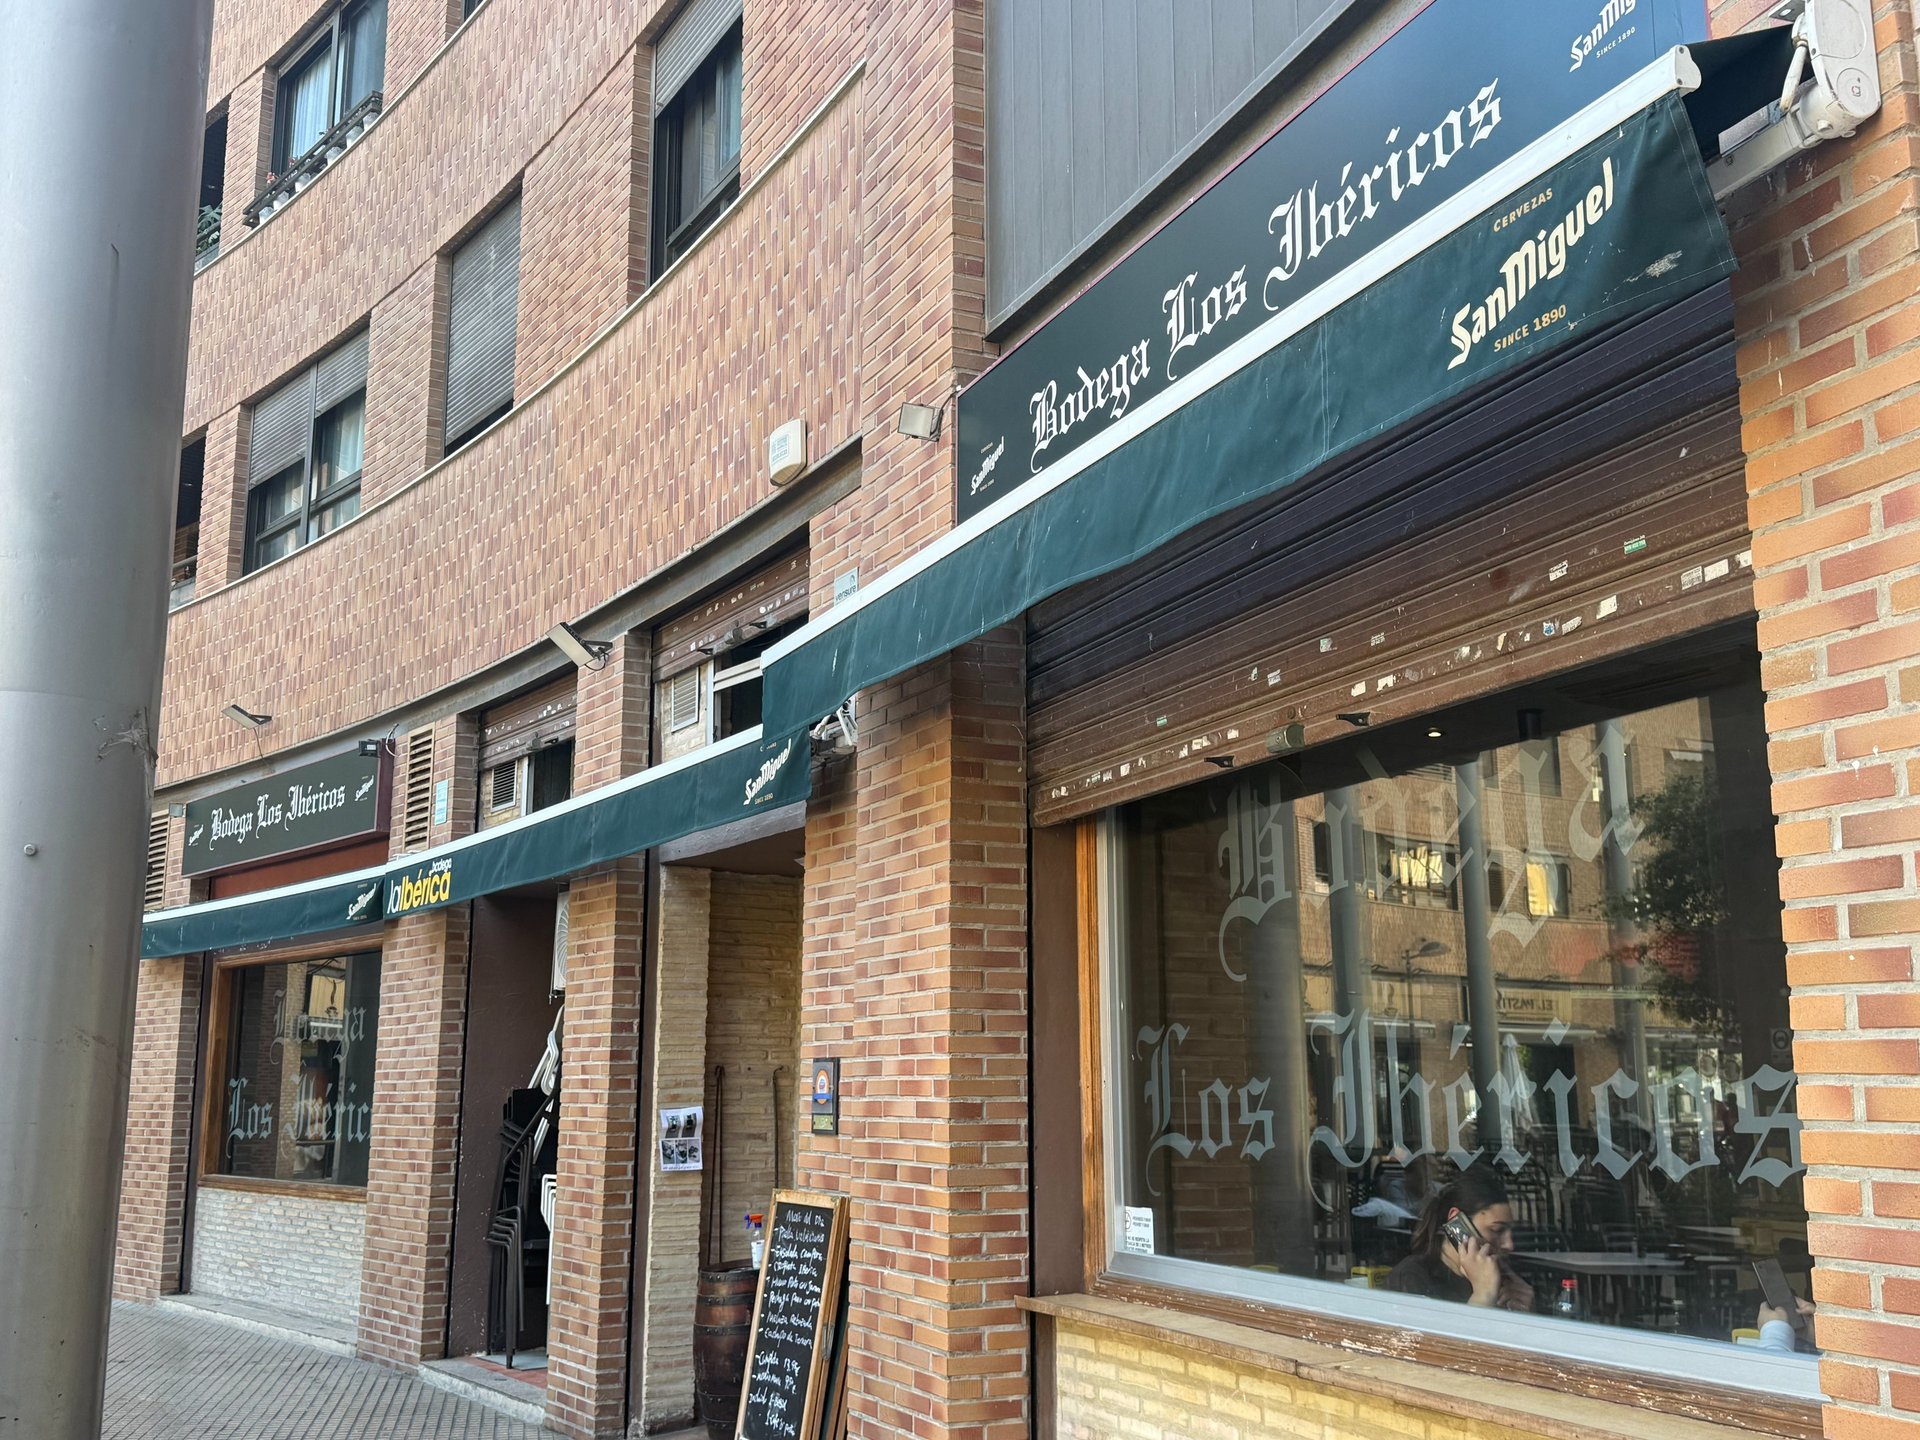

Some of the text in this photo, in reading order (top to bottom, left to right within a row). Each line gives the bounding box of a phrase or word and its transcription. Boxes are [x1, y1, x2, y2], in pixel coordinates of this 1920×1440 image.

[1596, 26, 1636, 58] SINCE 1890
[1493, 187, 1553, 233] CERVEZAS
[1030, 77, 1502, 474] Bodega Los Ibéricos
[1494, 304, 1567, 353] SINCE 1890
[209, 807, 252, 851] Bodega
[255, 793, 283, 839] Los
[284, 782, 346, 831] Ibéricos
[432, 857, 452, 873] bodega
[225, 1072, 373, 1160] Los Ibéric
[1136, 1007, 1808, 1213] Los Ibéricos
